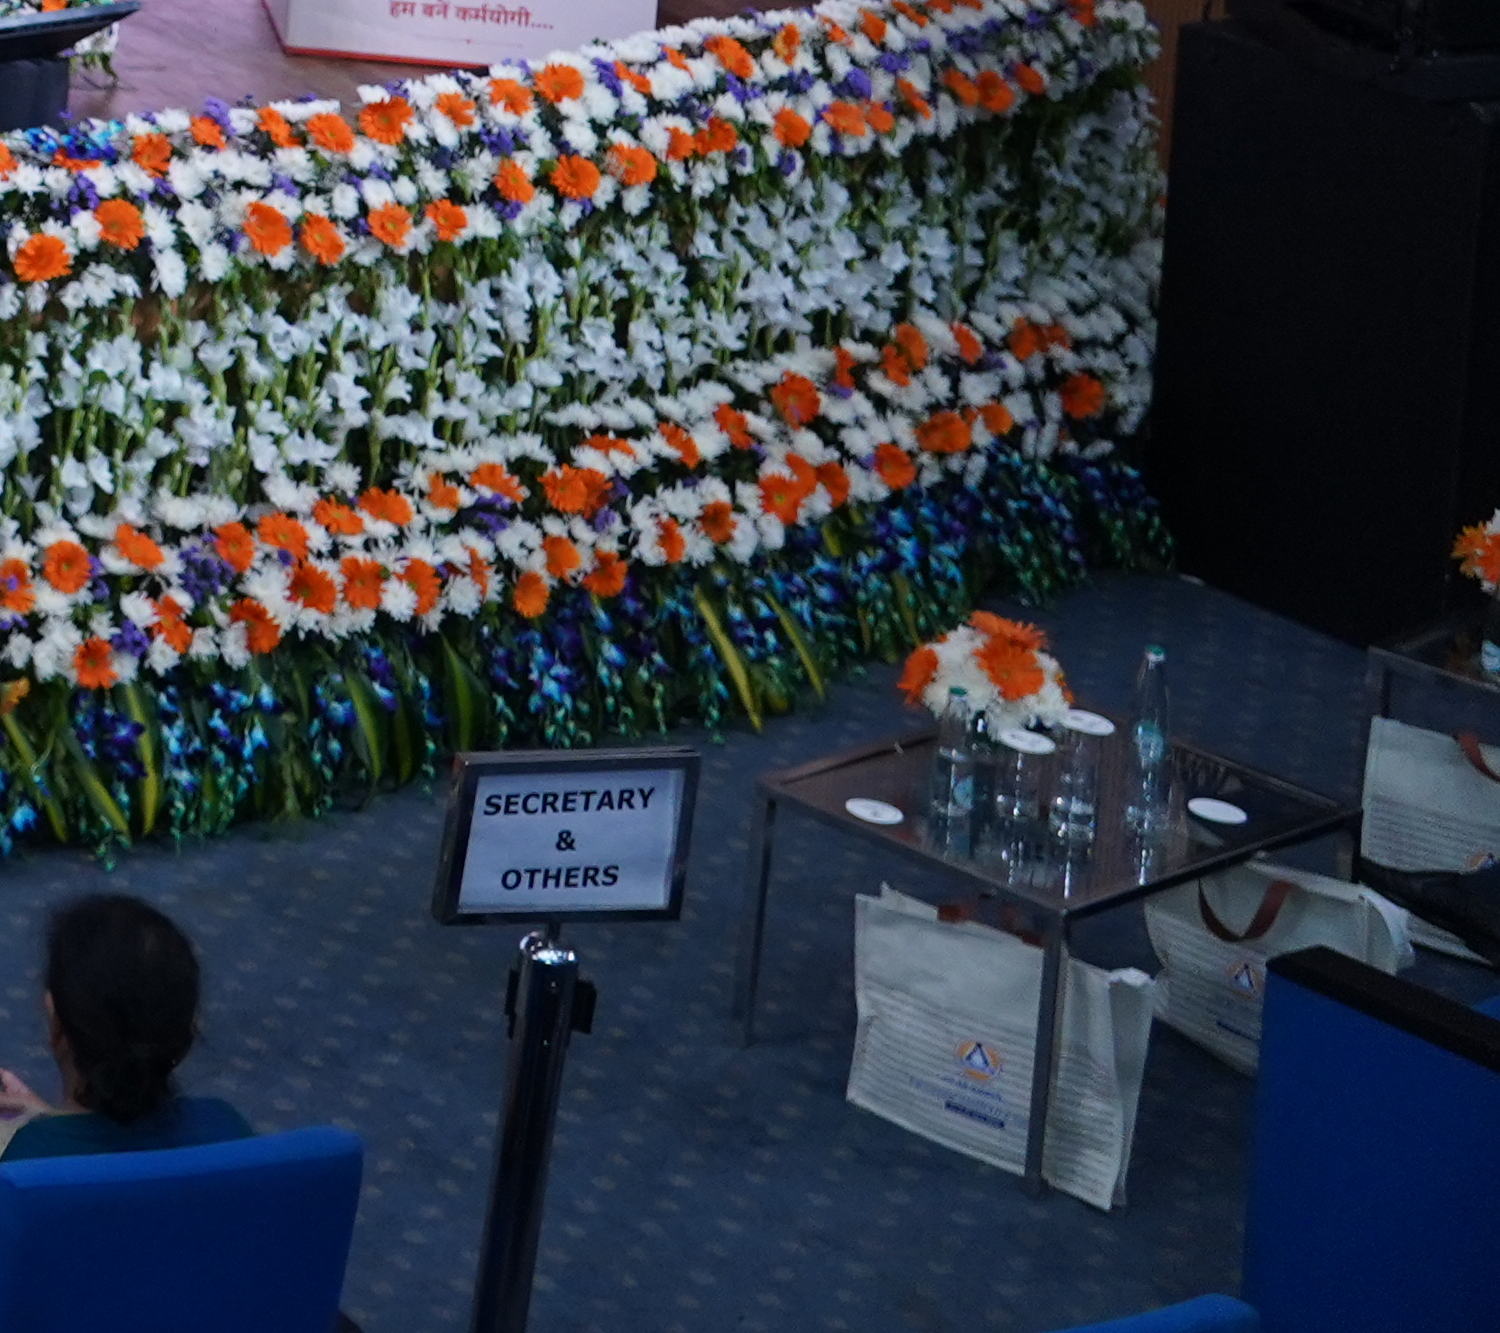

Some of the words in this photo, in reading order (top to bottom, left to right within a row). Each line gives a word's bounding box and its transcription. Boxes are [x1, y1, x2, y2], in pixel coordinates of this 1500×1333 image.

[482, 785, 658, 817] SECRETARY
[554, 829, 576, 852] &
[500, 863, 620, 891] OTHERS
